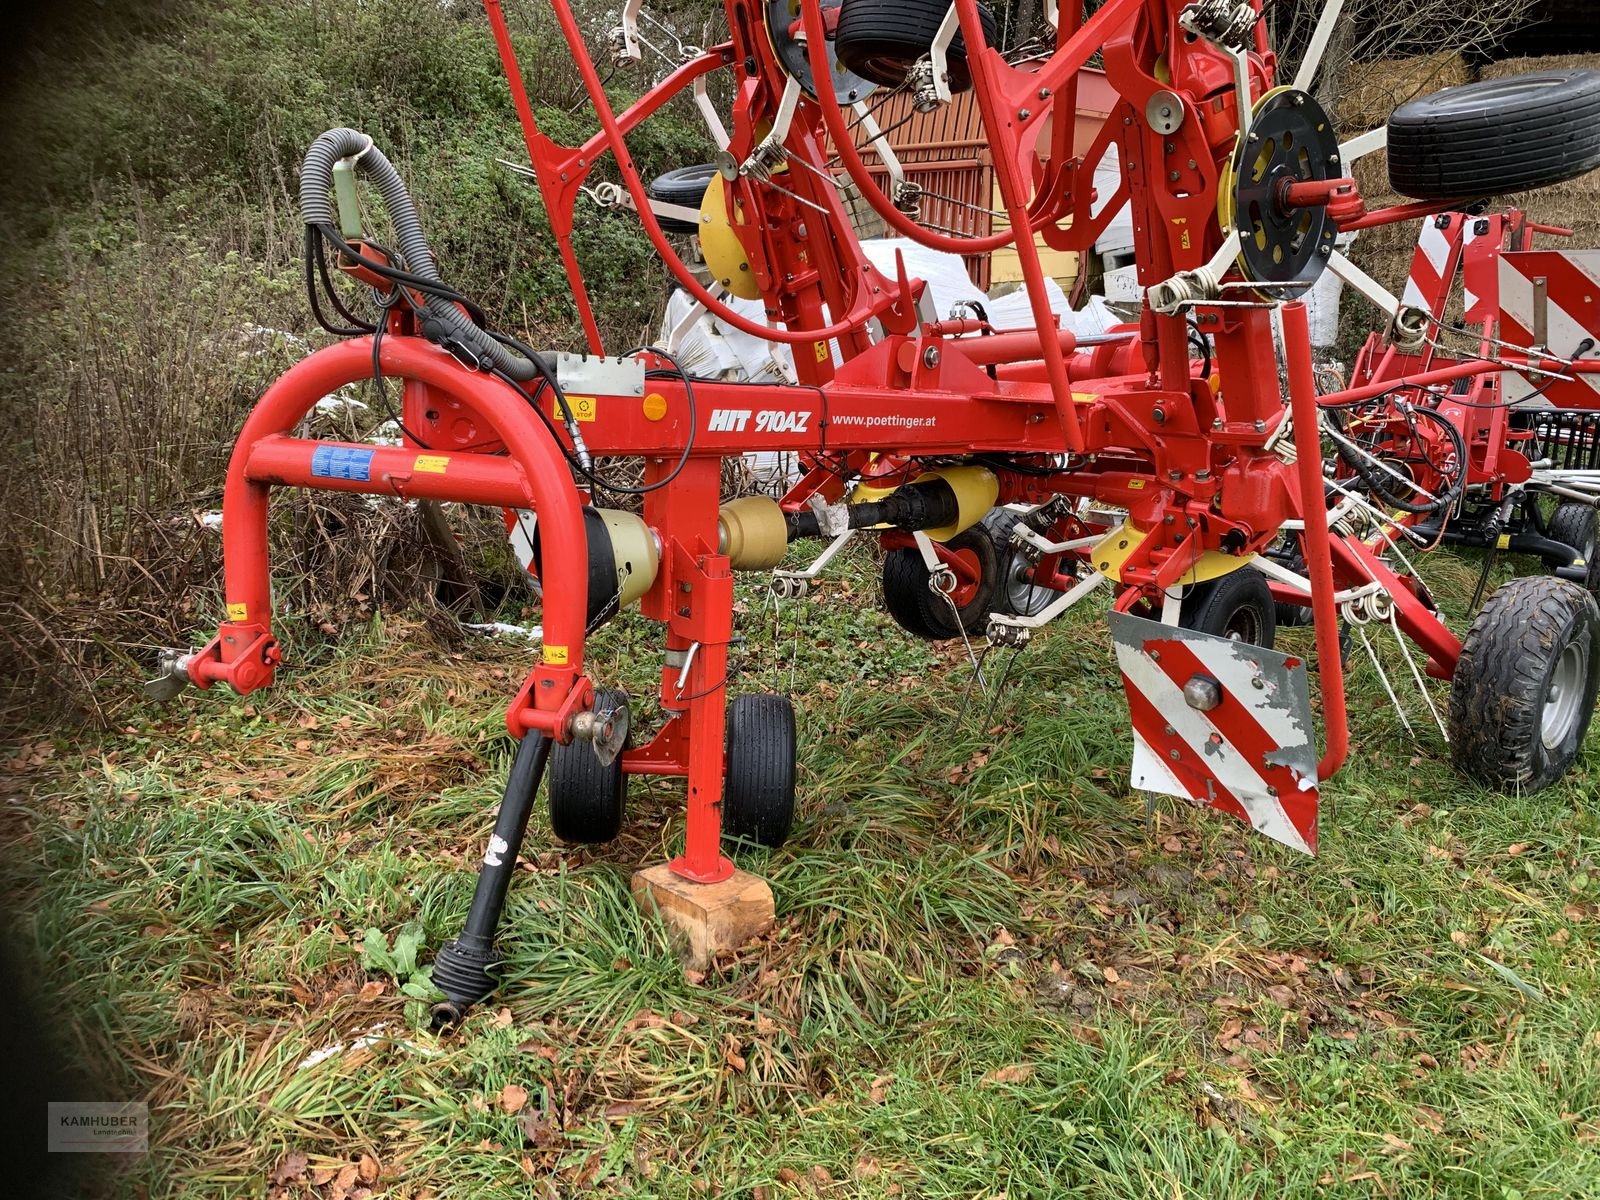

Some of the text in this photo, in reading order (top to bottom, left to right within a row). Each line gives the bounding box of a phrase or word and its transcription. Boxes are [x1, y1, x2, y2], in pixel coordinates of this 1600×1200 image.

[708, 409, 812, 433] HIT 910AZ
[832, 414, 937, 429] www.poettinger.at
